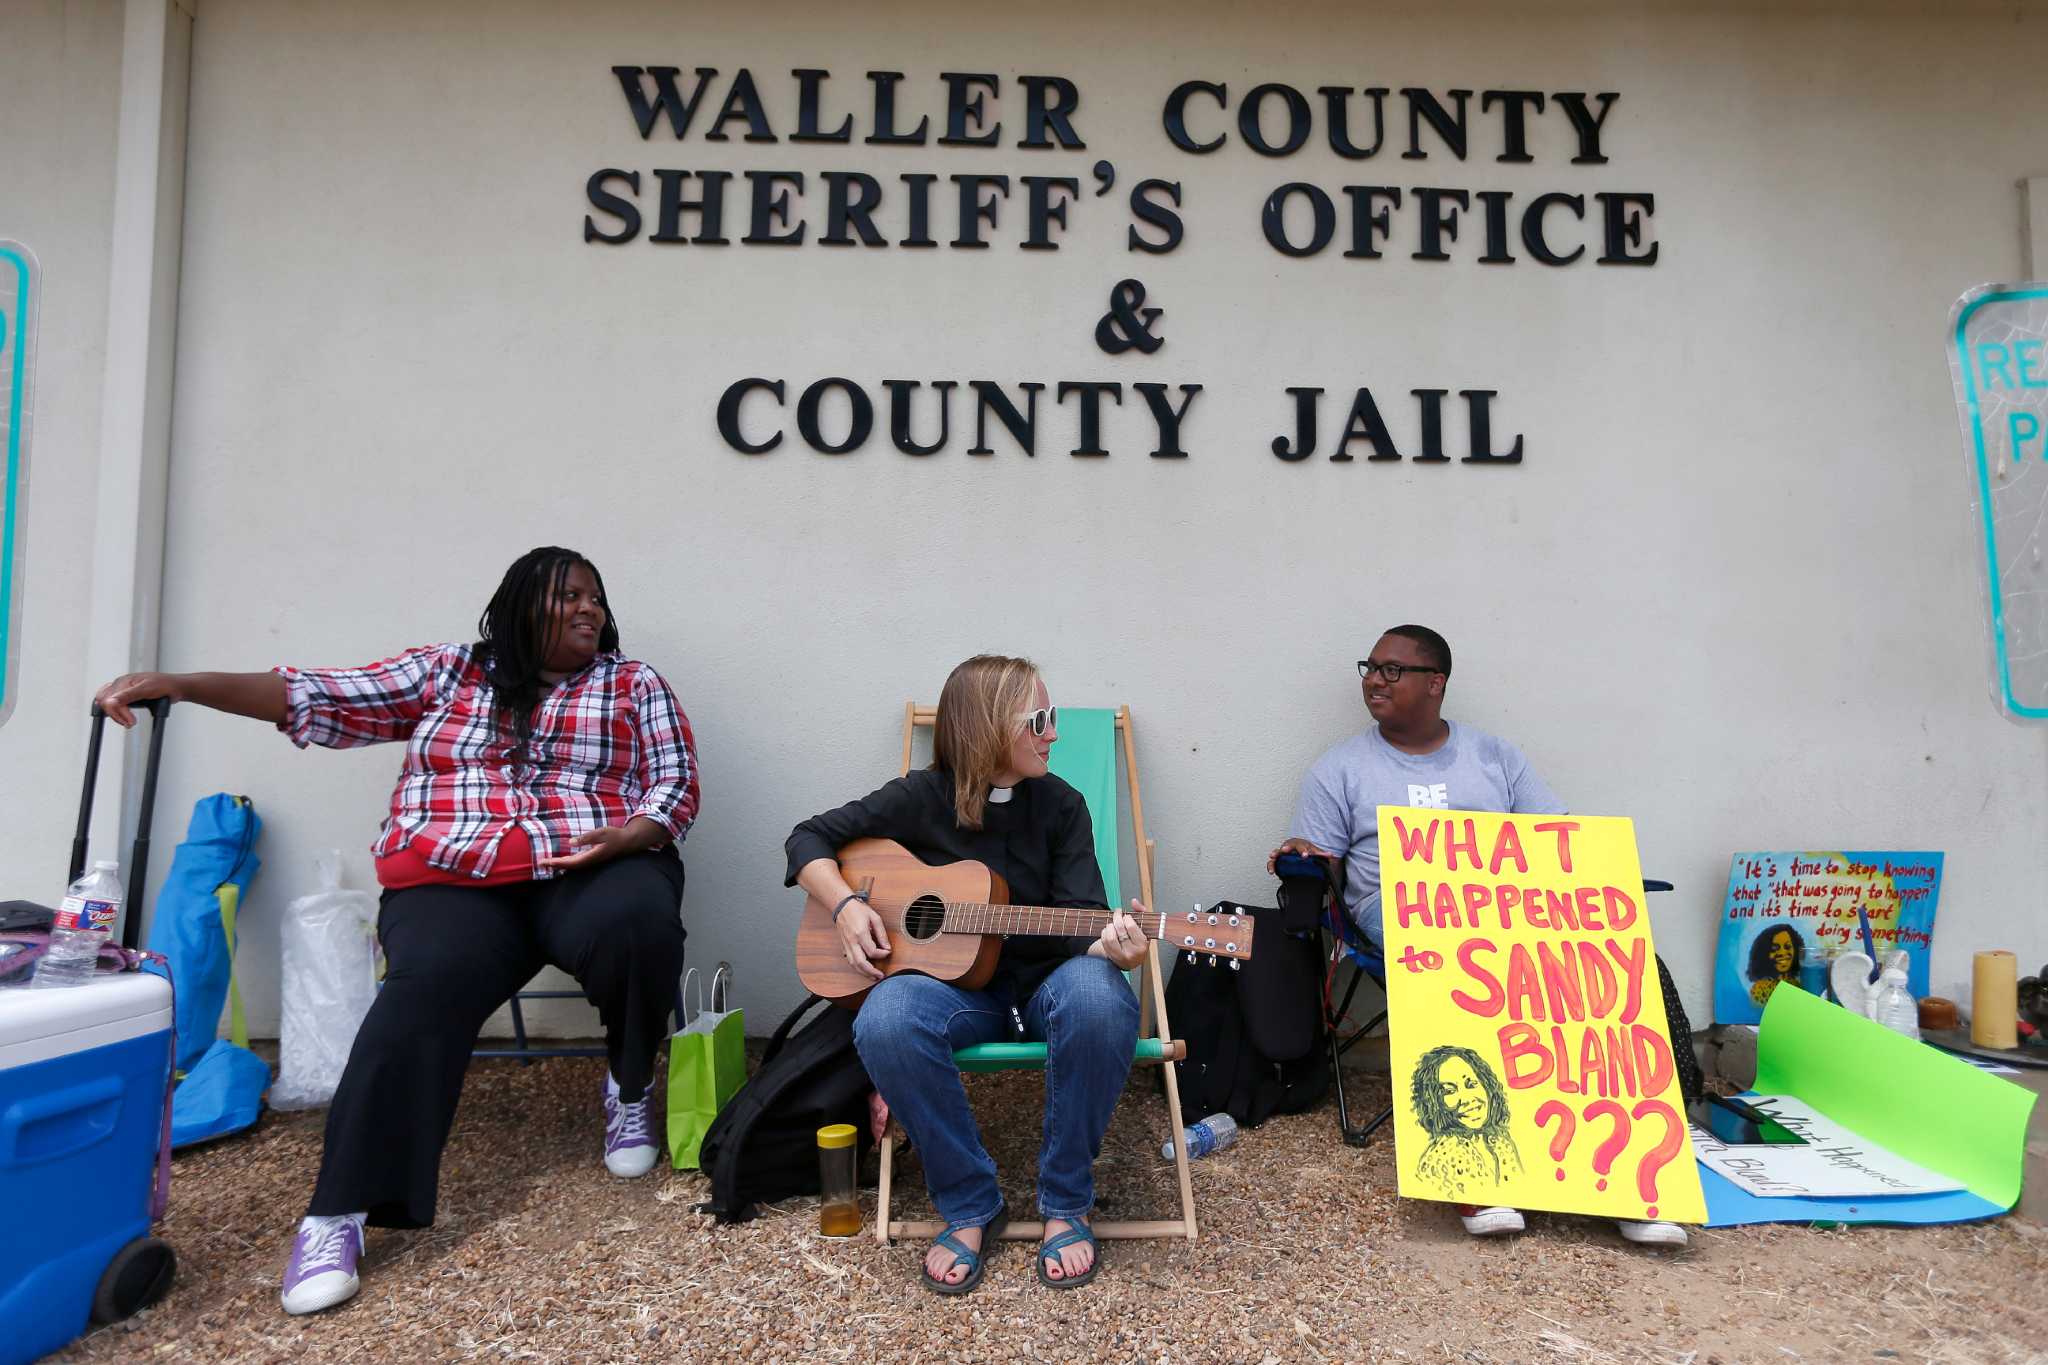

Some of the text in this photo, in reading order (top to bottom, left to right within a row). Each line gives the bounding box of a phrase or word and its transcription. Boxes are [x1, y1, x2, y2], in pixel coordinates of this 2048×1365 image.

[612, 66, 1620, 170] WALLER COUNTY
[585, 160, 1658, 266] SHERIFF'S OFFICE
[1095, 279, 1164, 355] &
[717, 378, 1523, 464] COUNTY JAIL
[1407, 783, 1449, 810] BE
[1393, 816, 1580, 875] WHAT
[1790, 856, 1821, 877] time
[1825, 858, 1840, 875] to
[1847, 860, 1878, 881] stop
[1395, 881, 1637, 931] HAPPENED
[1730, 903, 1755, 919] and
[1788, 899, 1819, 918] time
[1823, 901, 1842, 918] to
[1733, 883, 1761, 901] that
[1803, 885, 1828, 897] was
[1830, 884, 1861, 904] going
[1868, 883, 1883, 898] to
[1816, 921, 1850, 945] doing
[1397, 937, 1645, 1025] to SANDY
[1497, 1023, 1674, 1098] BLAND
